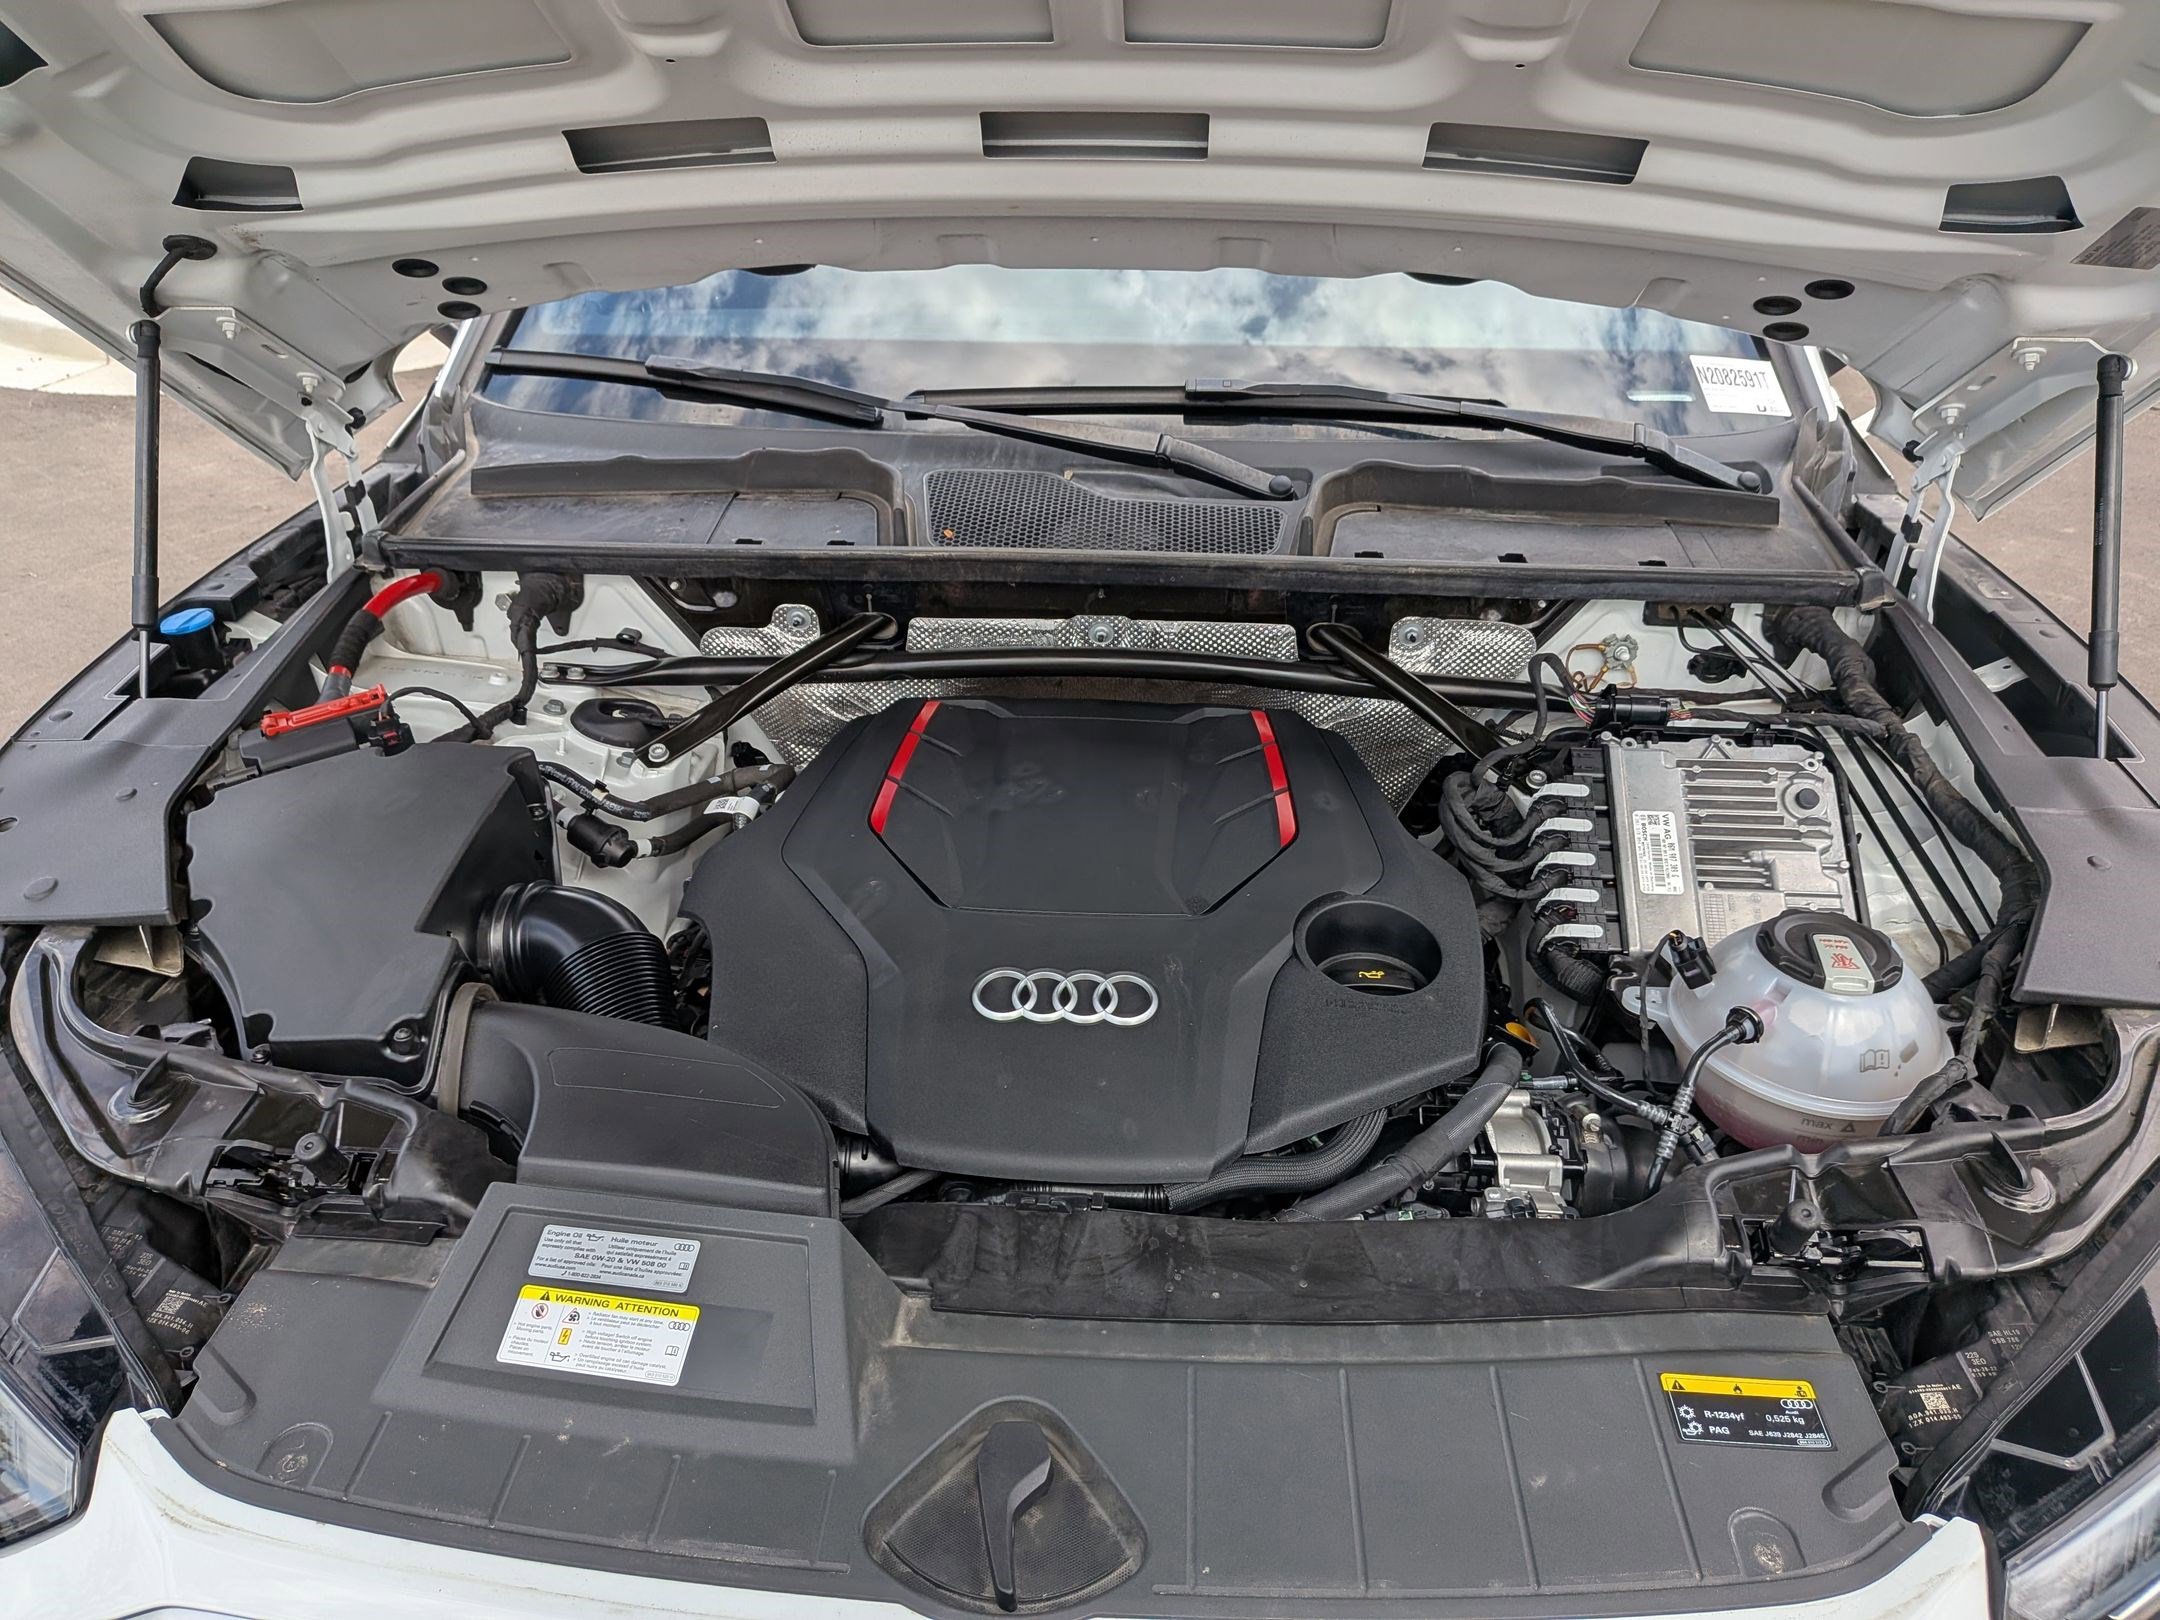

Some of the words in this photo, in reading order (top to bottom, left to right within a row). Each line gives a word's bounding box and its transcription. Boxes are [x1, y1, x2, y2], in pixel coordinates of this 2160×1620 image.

[1696, 366, 1768, 389] N2082591T
[1662, 814, 1670, 826] VW
[1664, 829, 1671, 840] AG
[1801, 1118, 1833, 1129] max
[546, 1229, 571, 1237] Engine
[554, 1294, 610, 1307] WARNING
[614, 1302, 679, 1316] ATTENTION
[1704, 1410, 1745, 1422] R-1234yf
[1766, 1414, 1792, 1423] 0,525
[1793, 1415, 1805, 1425] kg
[1709, 1426, 1730, 1435] PAG
